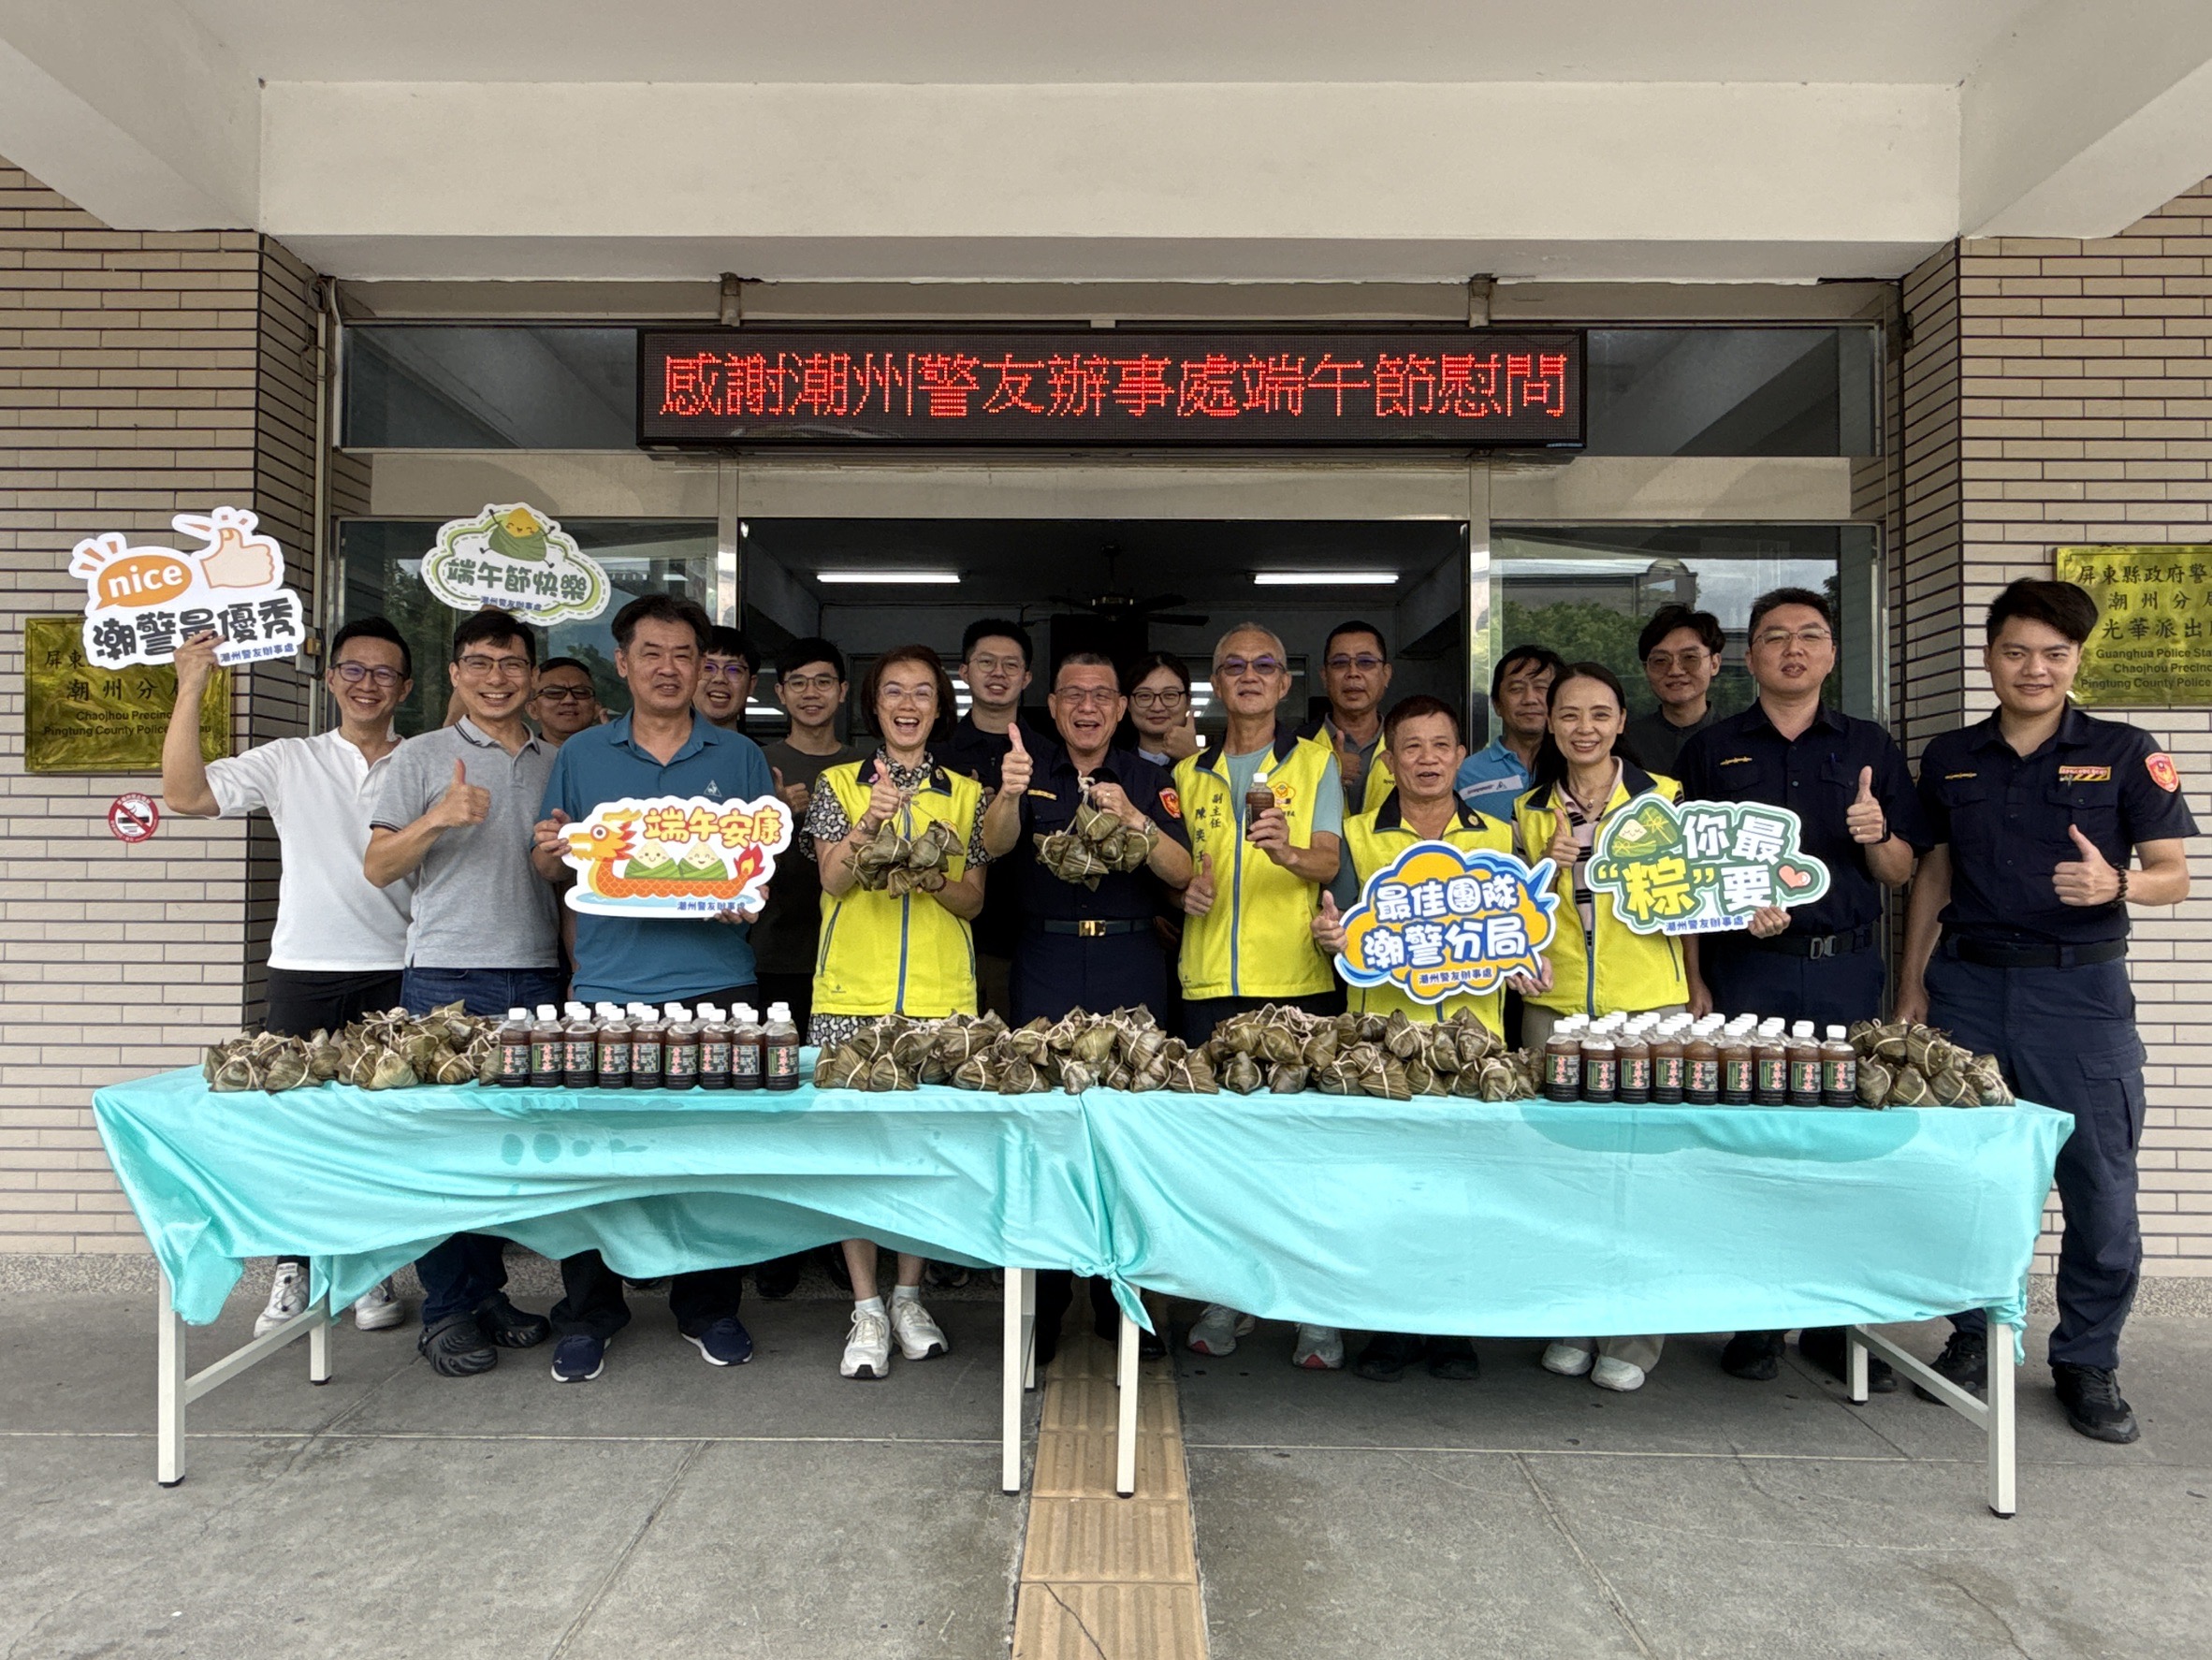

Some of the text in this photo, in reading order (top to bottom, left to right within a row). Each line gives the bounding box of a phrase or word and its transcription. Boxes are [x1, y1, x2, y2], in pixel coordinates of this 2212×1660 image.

[659, 352, 1567, 417] 感謝潮州警友辦事處端午節慰問
[108, 563, 182, 599] nice
[446, 559, 587, 601] 端午節快樂
[2076, 562, 2212, 585] 屏東縣政府警
[93, 597, 296, 660] 潮警最優秀
[2101, 617, 2212, 641] 光華派出
[2096, 648, 2154, 661] Guanghua
[2157, 648, 2190, 658] Police
[2113, 663, 2168, 675] Chaojhou
[66, 677, 179, 702] 潮州分
[2080, 677, 2211, 690] Pingtung County Police
[76, 710, 129, 721] Chaojhou
[95, 725, 135, 736] County
[642, 805, 784, 849] 端午安康
[1681, 813, 1785, 865] 你最
[1376, 873, 1519, 922] 最佳團隊
[1363, 915, 1526, 969] 潮警分局
